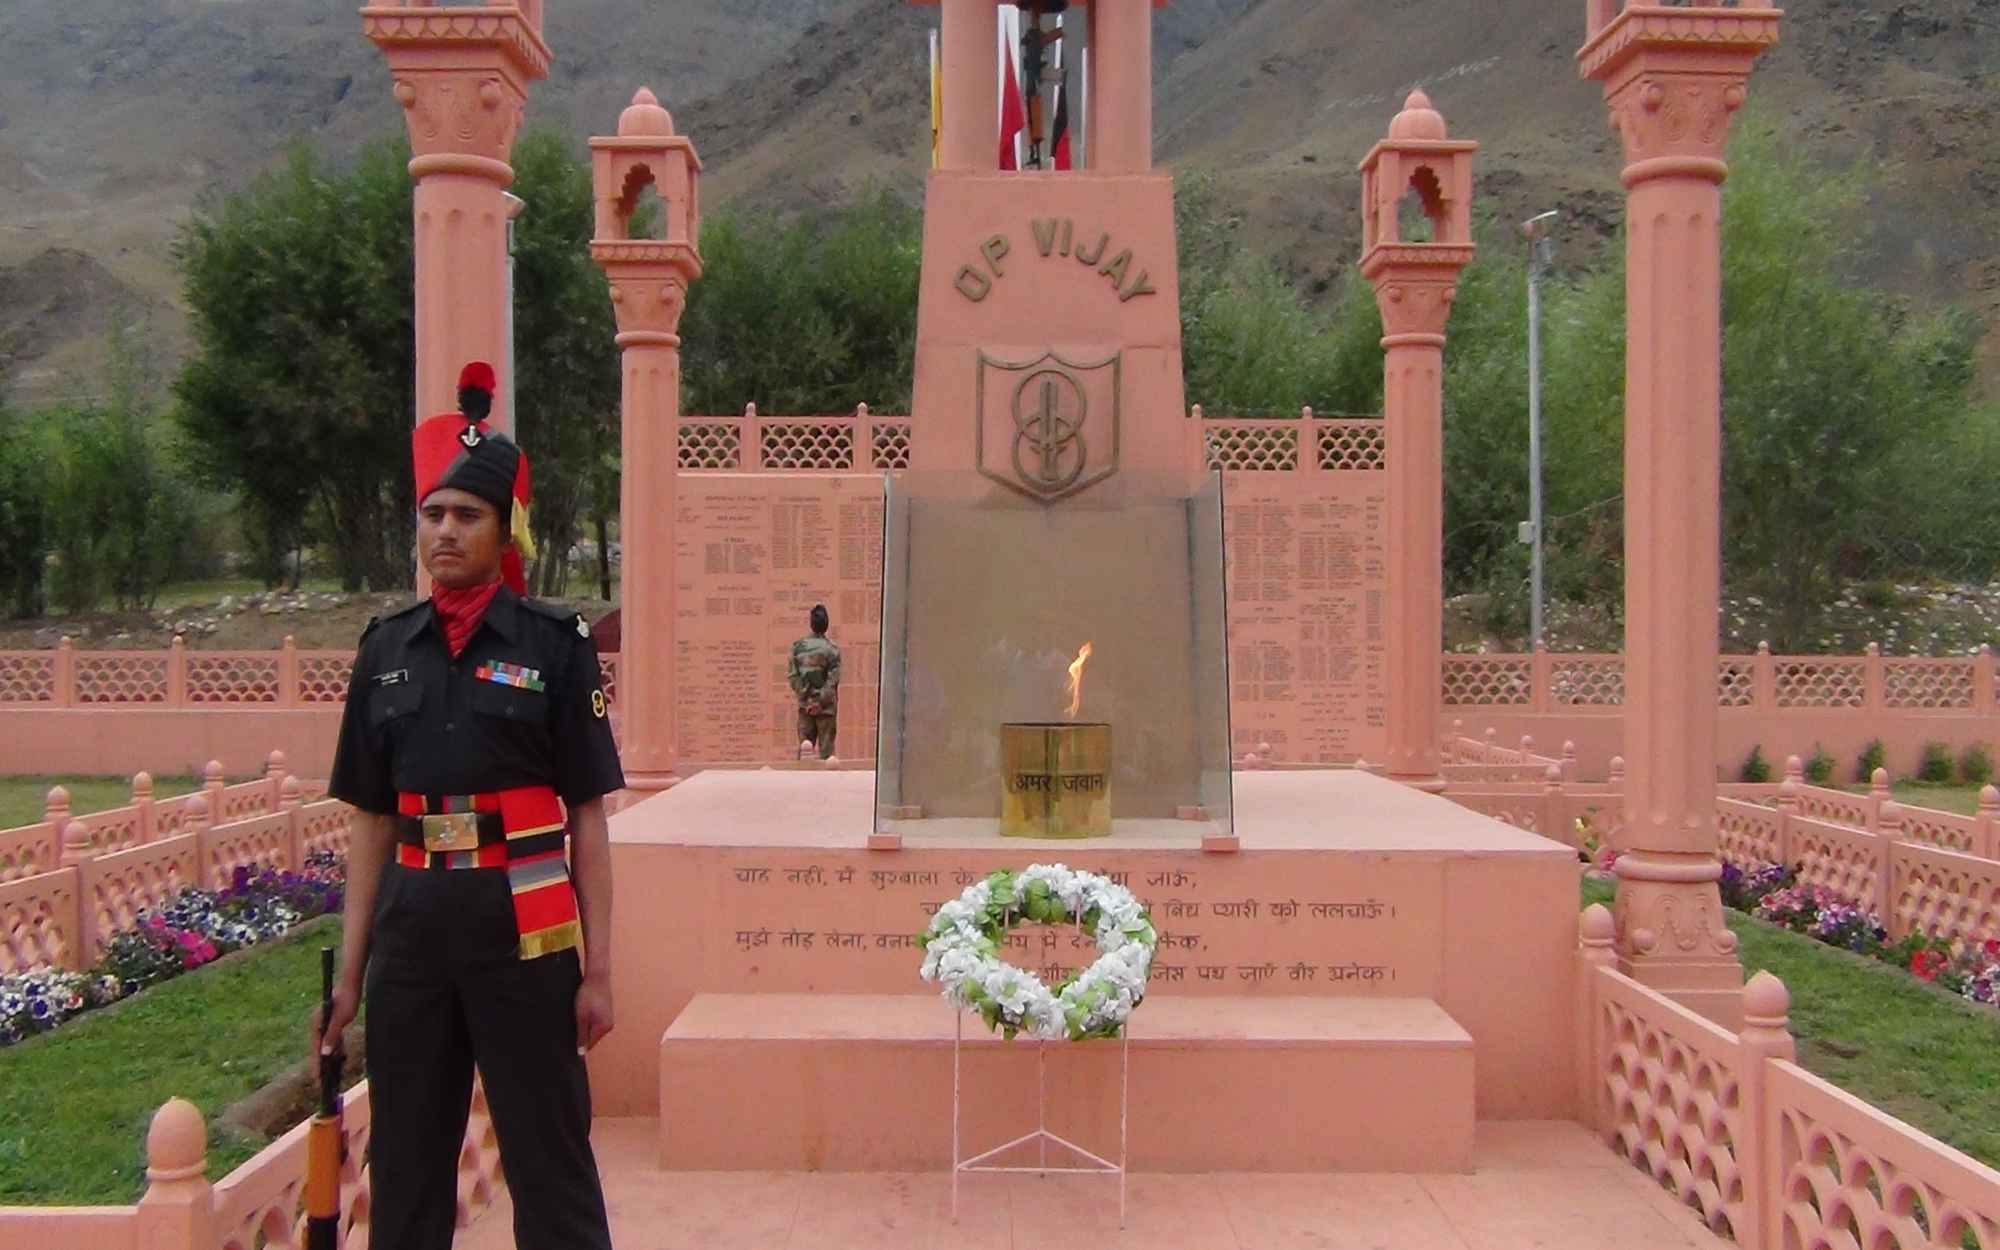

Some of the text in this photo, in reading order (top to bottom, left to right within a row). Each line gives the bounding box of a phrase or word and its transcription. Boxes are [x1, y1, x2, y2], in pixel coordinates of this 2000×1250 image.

[954, 217, 1157, 303] OP VIJAY
[1015, 772, 1104, 793] अमर जवान
[1269, 899, 1299, 918] को
[1195, 965, 1227, 980] पथ
[1286, 962, 1318, 980] वीर
